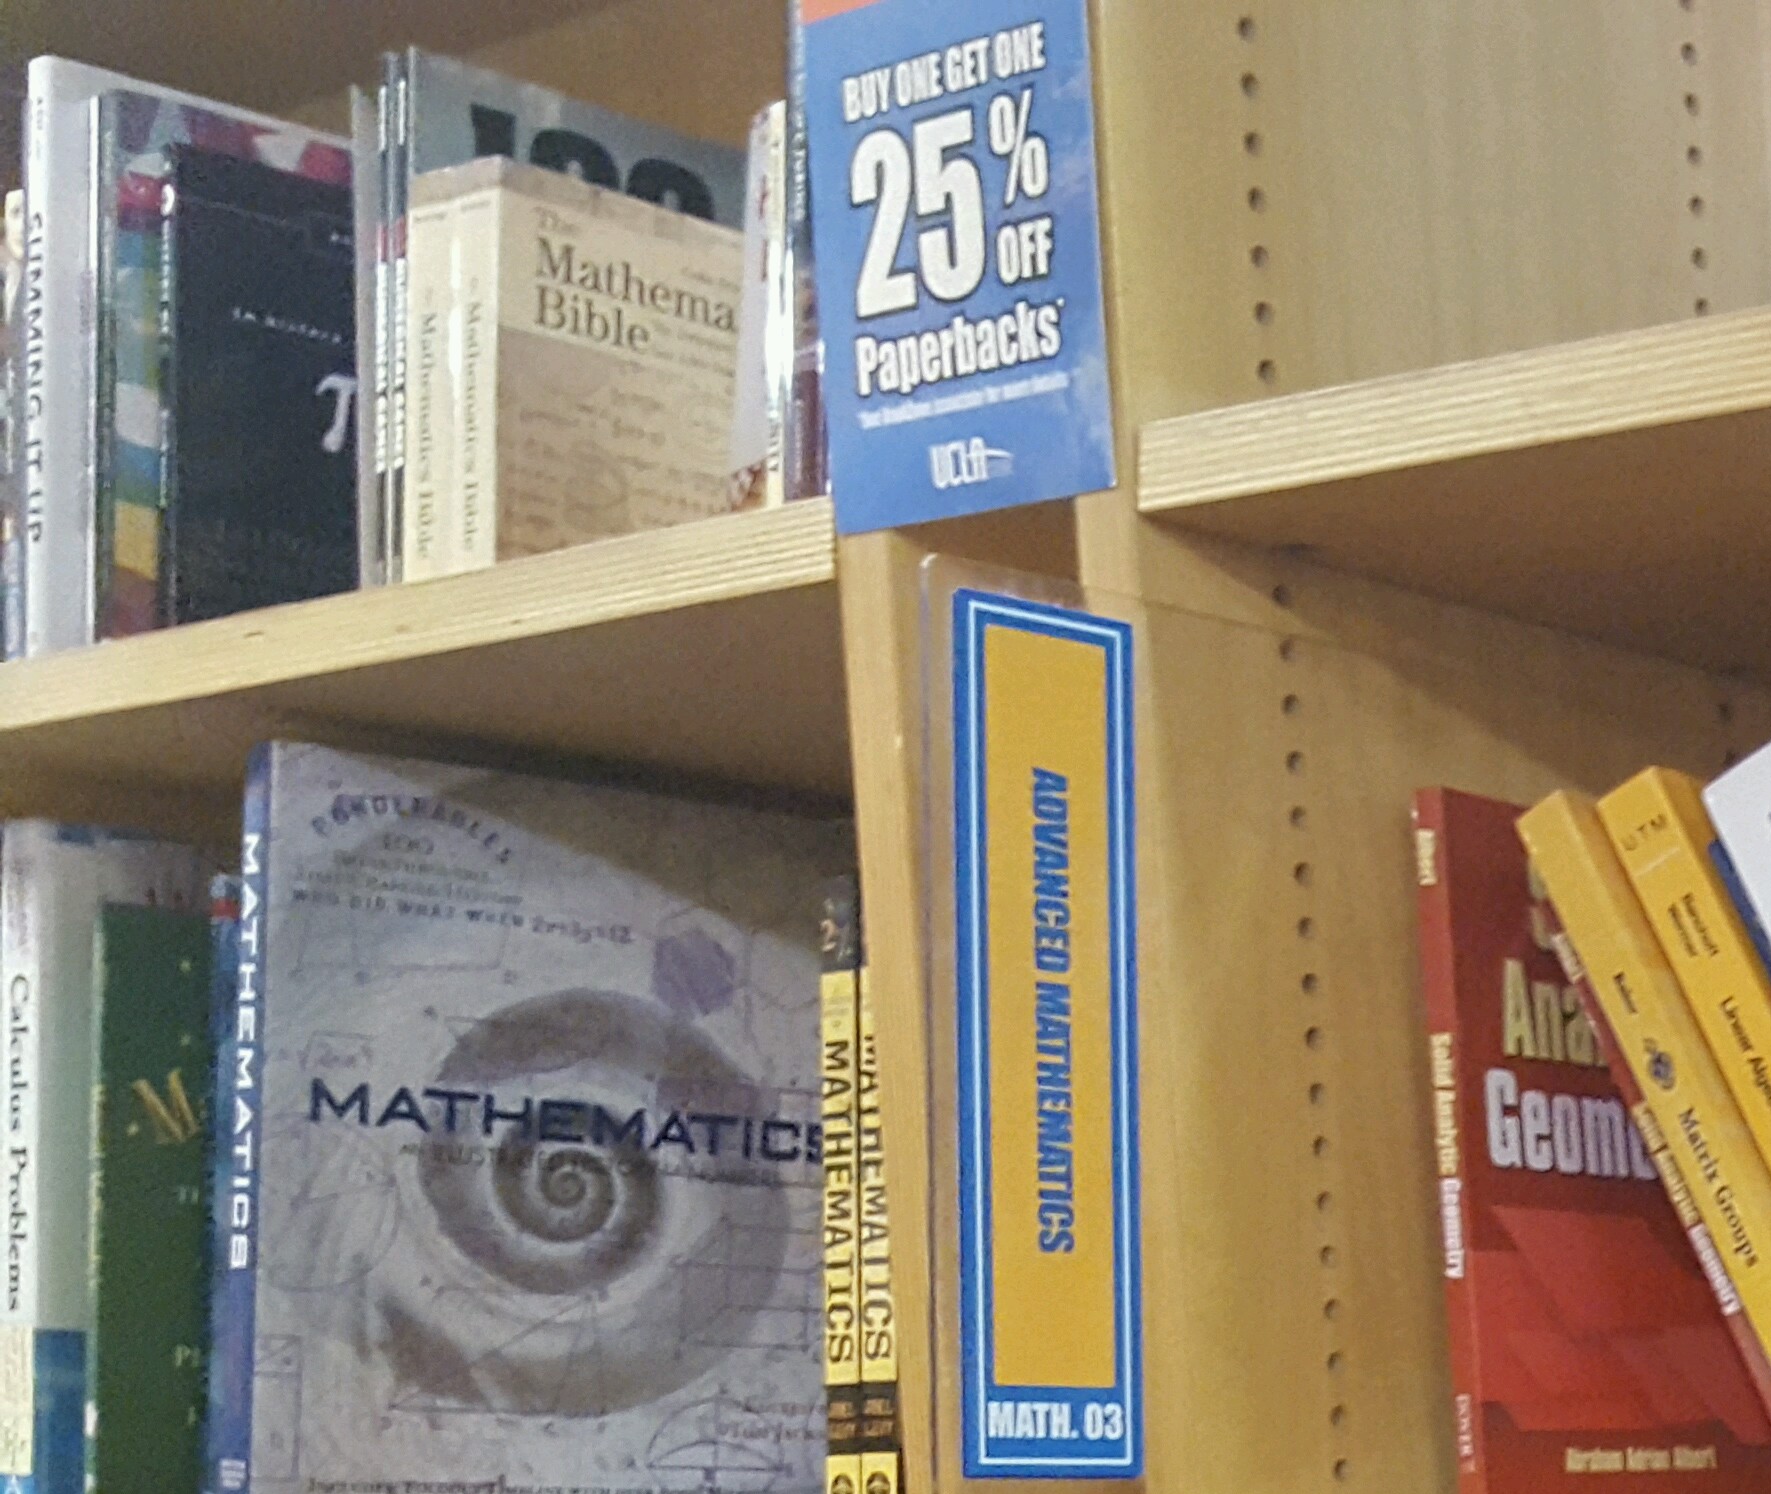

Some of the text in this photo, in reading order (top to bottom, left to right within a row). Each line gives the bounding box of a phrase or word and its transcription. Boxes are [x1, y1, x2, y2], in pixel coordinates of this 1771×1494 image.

[842, 22, 1046, 122] BUY ONE GET ONE
[534, 238, 738, 334] Mathema
[996, 214, 1056, 286] OFF
[533, 283, 651, 355] Bible
[27, 213, 43, 544] SUMMING IT UP
[928, 436, 996, 489] UCLA
[1620, 813, 1670, 853] UTM
[229, 834, 262, 1270] MATHEMATICS
[1031, 767, 1075, 1254] ADVANCED MATHEMATICS
[1719, 996, 1749, 1050] Linear
[7, 972, 31, 1311] Calculus Problems
[309, 1076, 823, 1166] MATHEMATICS
[823, 1039, 856, 1363] MATHEMATICS
[1678, 1106, 1761, 1270] Matrix Groups
[986, 1401, 1124, 1442] MATH. 03
